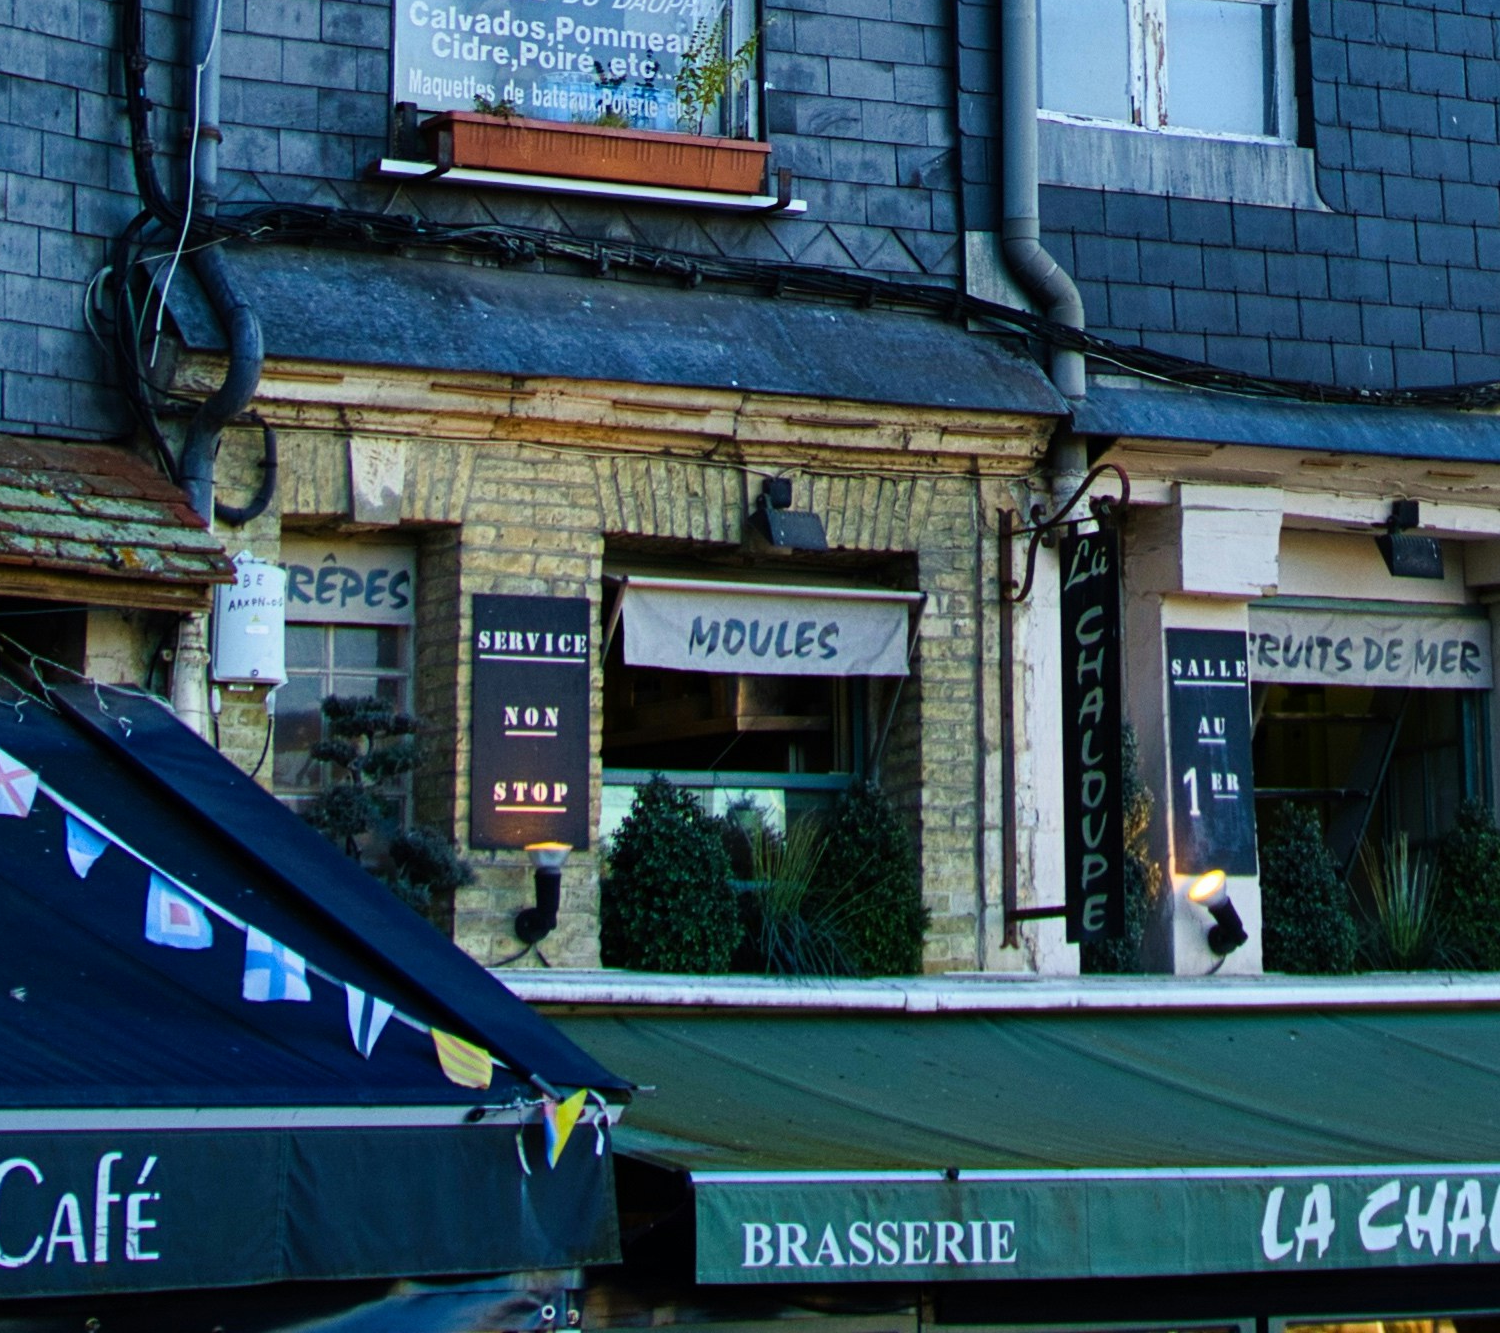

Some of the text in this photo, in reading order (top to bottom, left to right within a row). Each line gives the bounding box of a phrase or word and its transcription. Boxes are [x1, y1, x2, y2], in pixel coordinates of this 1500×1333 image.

[408, 68, 495, 103] Maquettes
[503, 79, 524, 104] de
[278, 553, 411, 610] RÊPES
[478, 630, 588, 654] SERVICE
[688, 615, 840, 660] MOULES
[1171, 659, 1247, 678] SALLE
[1362, 636, 1404, 673] DE
[1413, 638, 1482, 676] MER
[504, 706, 560, 727] NON
[1198, 717, 1226, 735] AU
[1075, 605, 1108, 931] CHALOUPE
[493, 781, 569, 803] STOP
[741, 1219, 1017, 1270] BRASSERIE
[1261, 1183, 1335, 1263] LA
